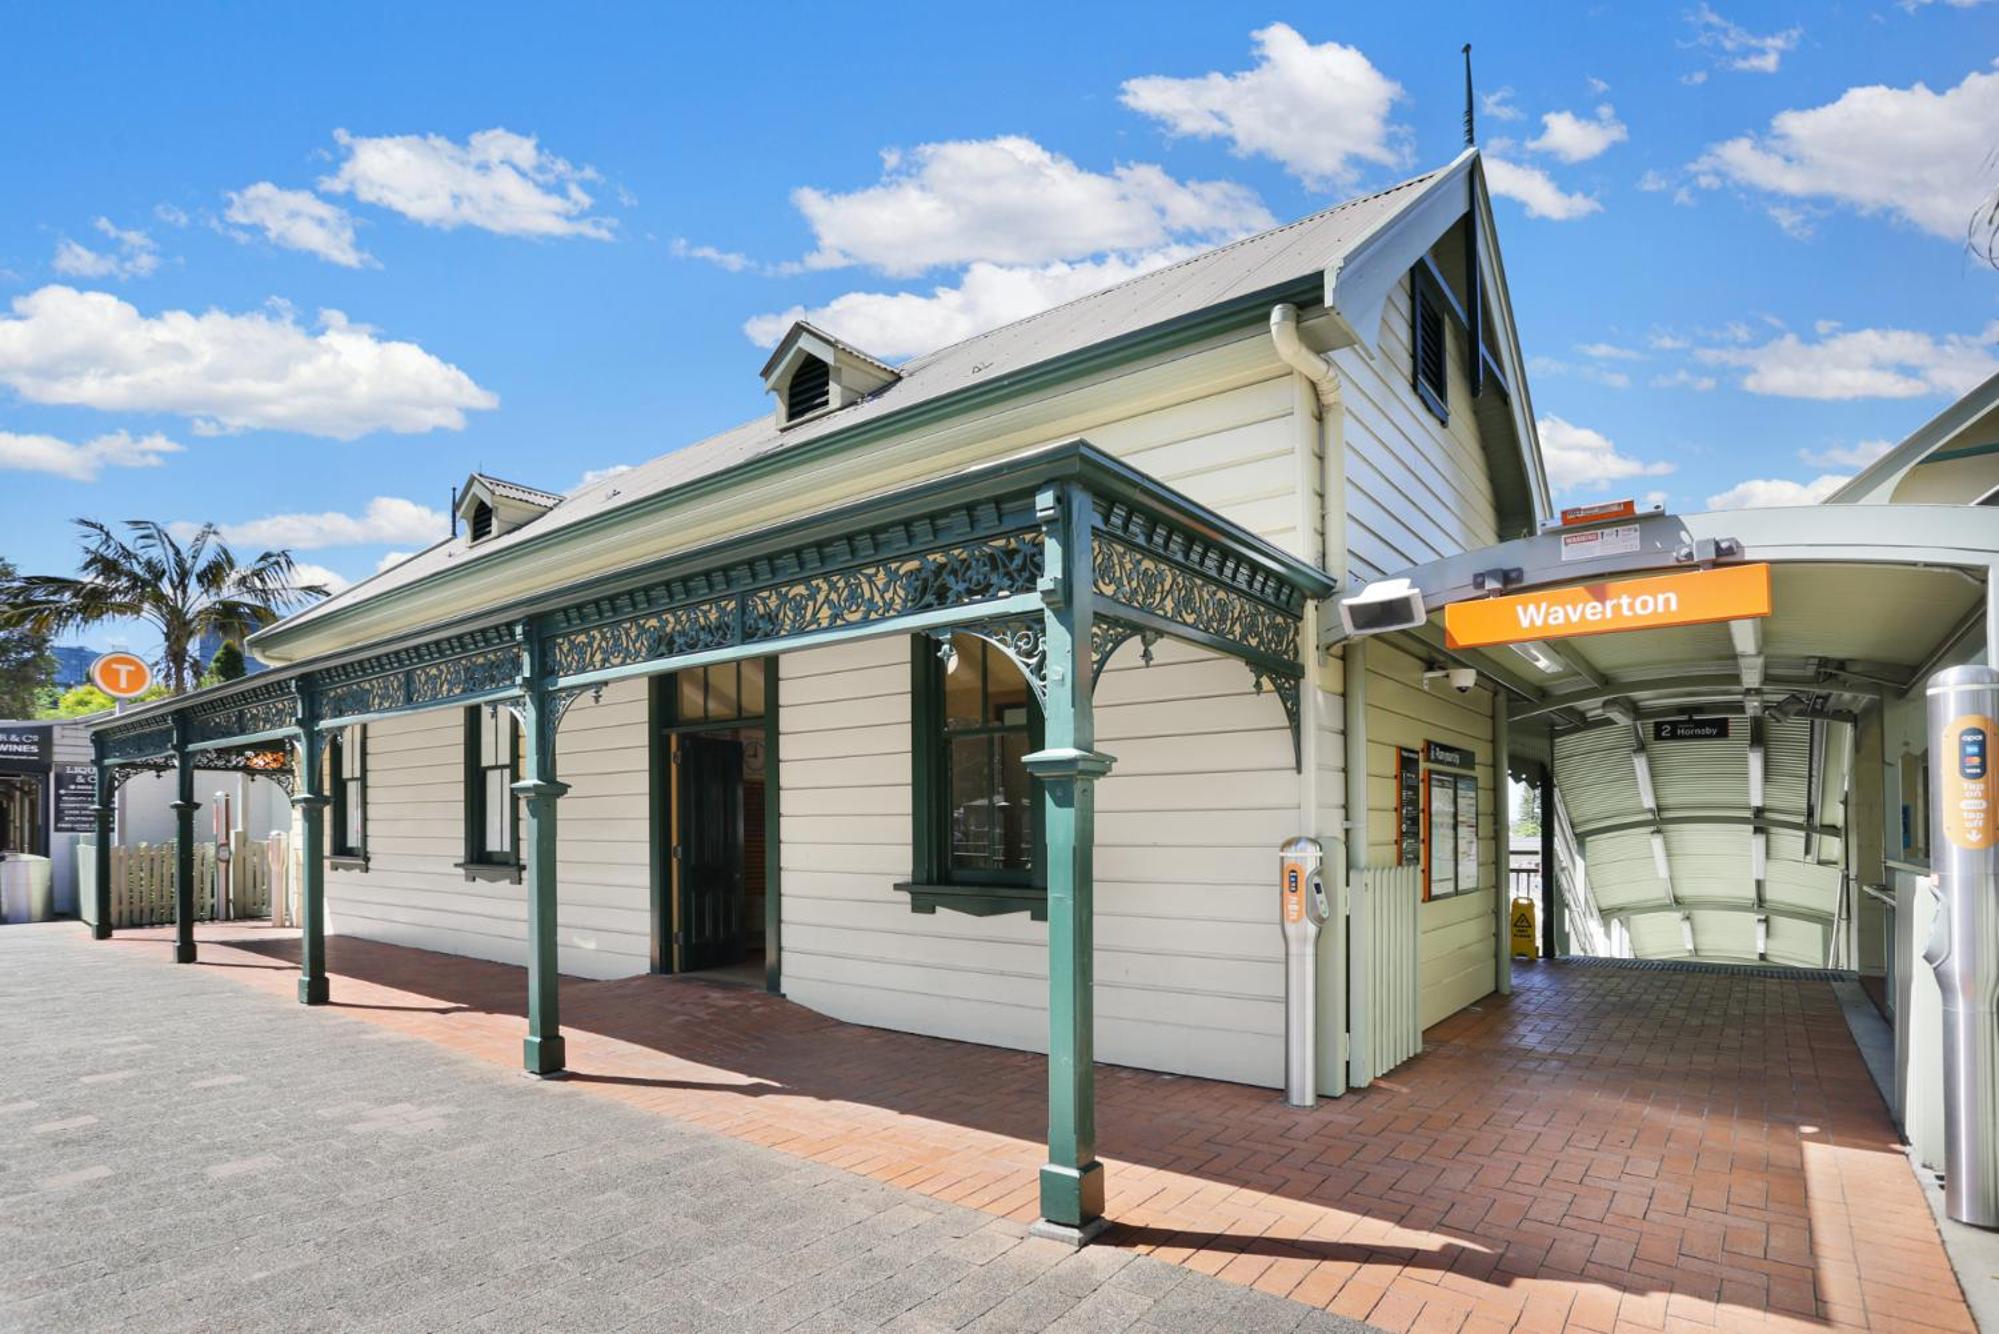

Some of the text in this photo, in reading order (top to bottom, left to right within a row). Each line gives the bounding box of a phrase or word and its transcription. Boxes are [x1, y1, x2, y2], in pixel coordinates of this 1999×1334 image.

[1516, 591, 1678, 629] Waverton
[111, 664, 135, 689] T
[1661, 725, 1671, 736] 2
[1677, 727, 1718, 736] Hornsby
[10, 734, 20, 742] &
[0, 744, 39, 752] WINES
[65, 766, 97, 774] LIQU
